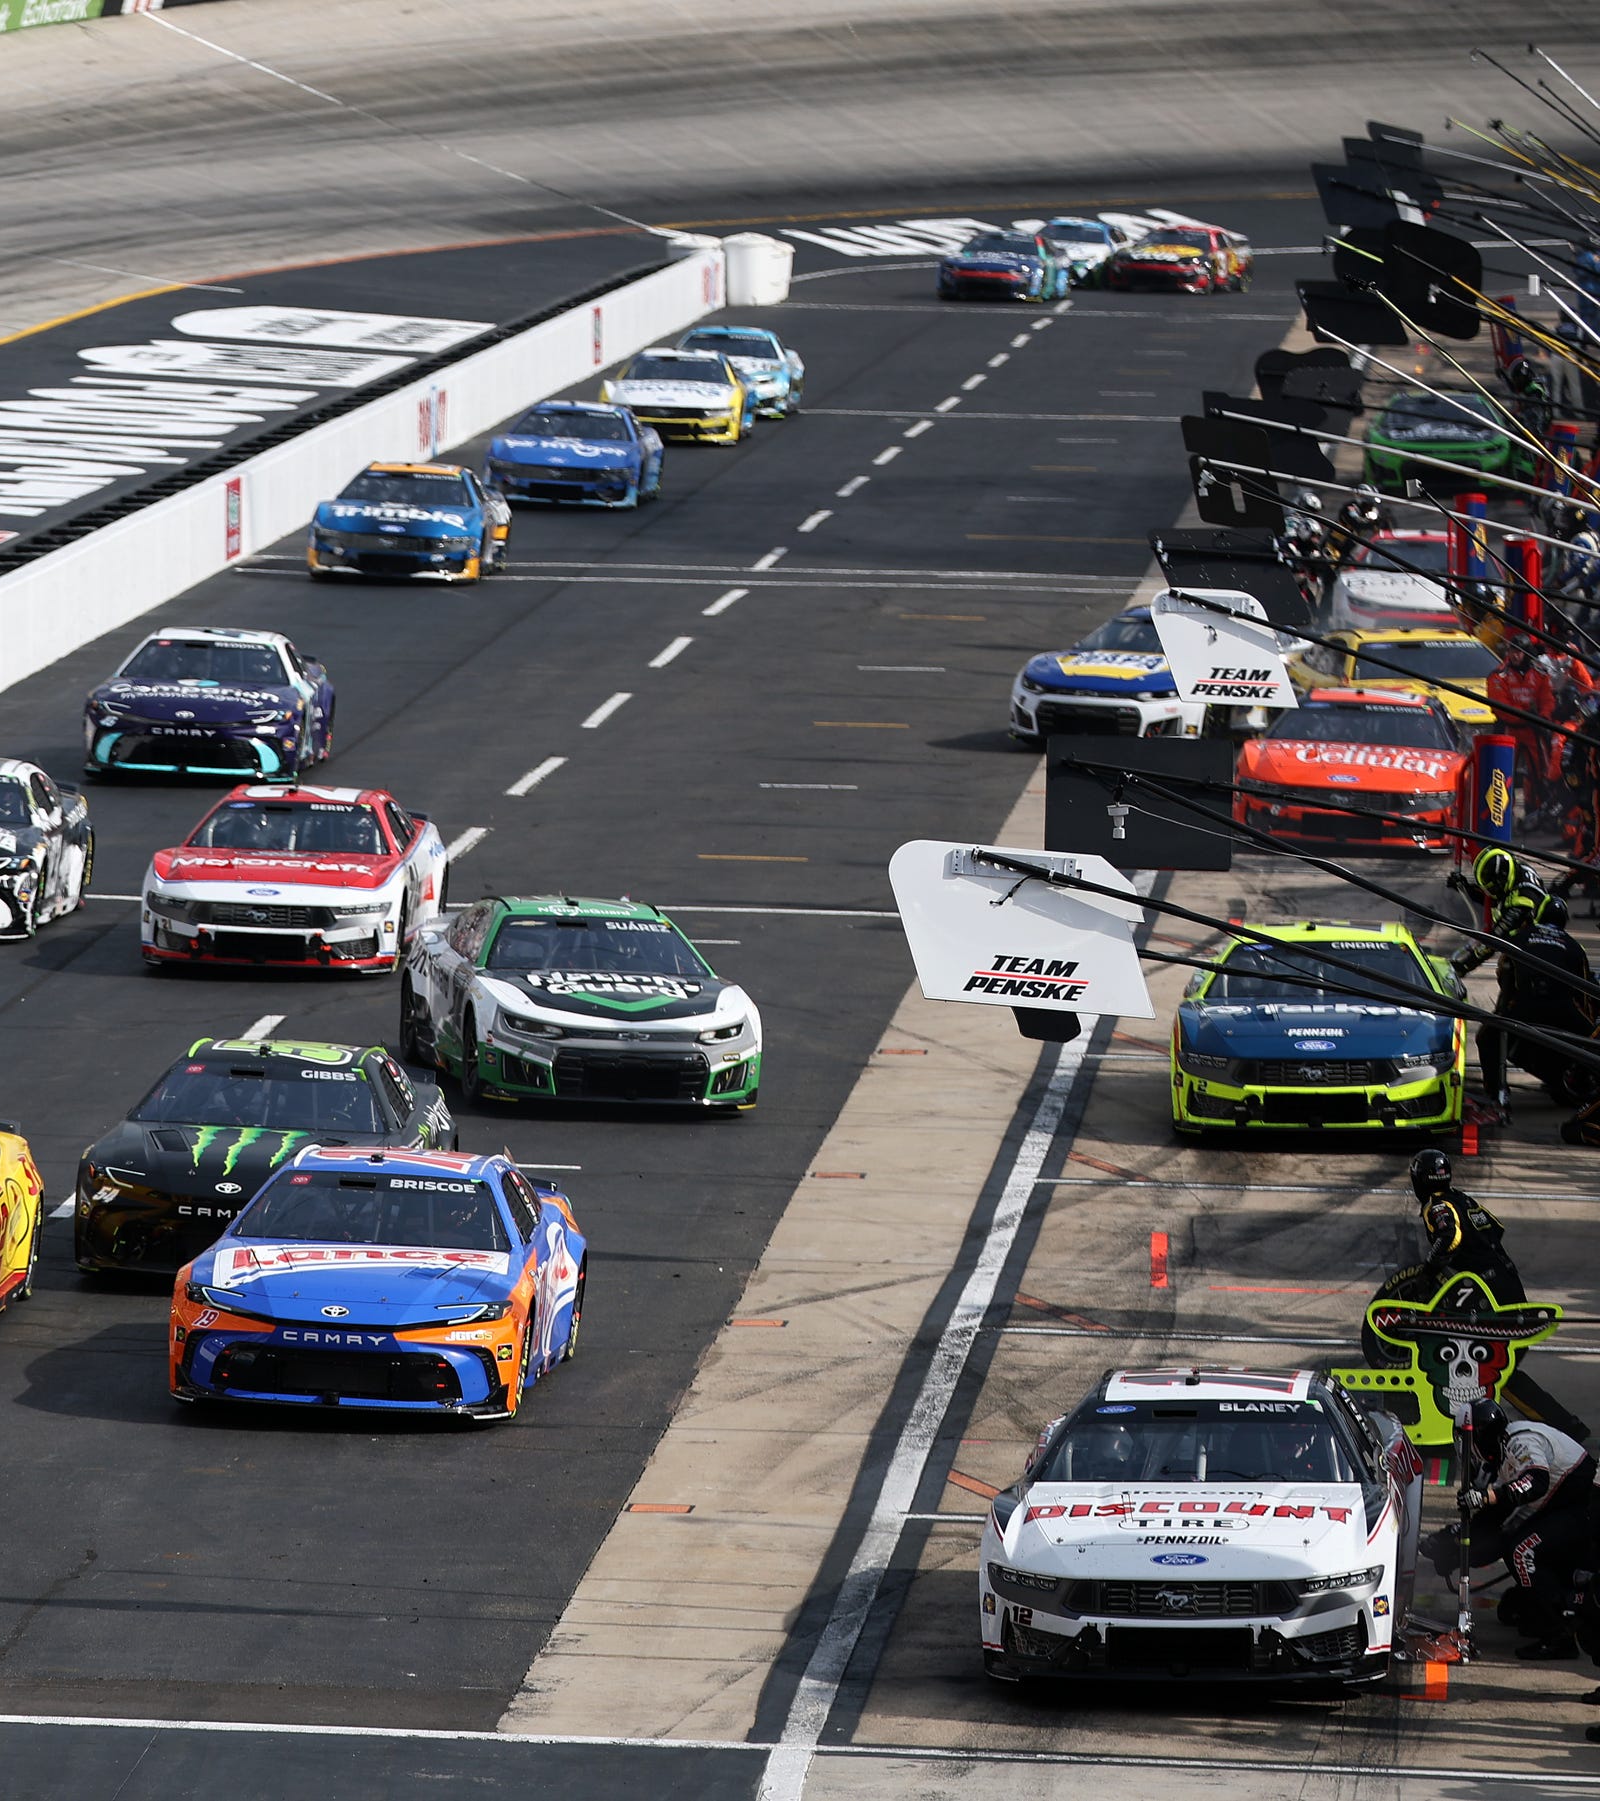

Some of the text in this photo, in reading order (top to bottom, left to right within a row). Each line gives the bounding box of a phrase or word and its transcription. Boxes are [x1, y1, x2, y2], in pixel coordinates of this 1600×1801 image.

[331, 506, 468, 531] Trimble
[214, 641, 266, 650] REDDICK
[1209, 667, 1272, 682] TEAM
[1190, 684, 1278, 699] PENSKE
[151, 727, 217, 738] CAMRY
[1295, 746, 1448, 779] Cellular
[1491, 768, 1505, 827] SUNOCO
[310, 803, 355, 813] BERRY
[171, 857, 374, 877] Motorcraft
[605, 920, 672, 934] SUÁREZ
[1330, 941, 1390, 951] CINDRIC
[990, 954, 1080, 978] TEAM
[547, 982, 689, 1000] Guard
[962, 976, 1090, 1002] PENSKE
[1287, 1027, 1346, 1038] PENNZOIL
[301, 1069, 357, 1082] GIBBS
[390, 1178, 477, 1194] BRISCOE
[232, 1249, 491, 1271] Lance
[1455, 1287, 1474, 1308] 7
[192, 1309, 220, 1329] 19
[282, 1330, 387, 1347] CAMRY
[1219, 1402, 1299, 1414] BLANEY
[1024, 1501, 1353, 1524] DISCOUNT
[1138, 1518, 1235, 1529] TIRE
[1143, 1534, 1223, 1546] PENNZOIL
[1012, 1604, 1034, 1626] 12
